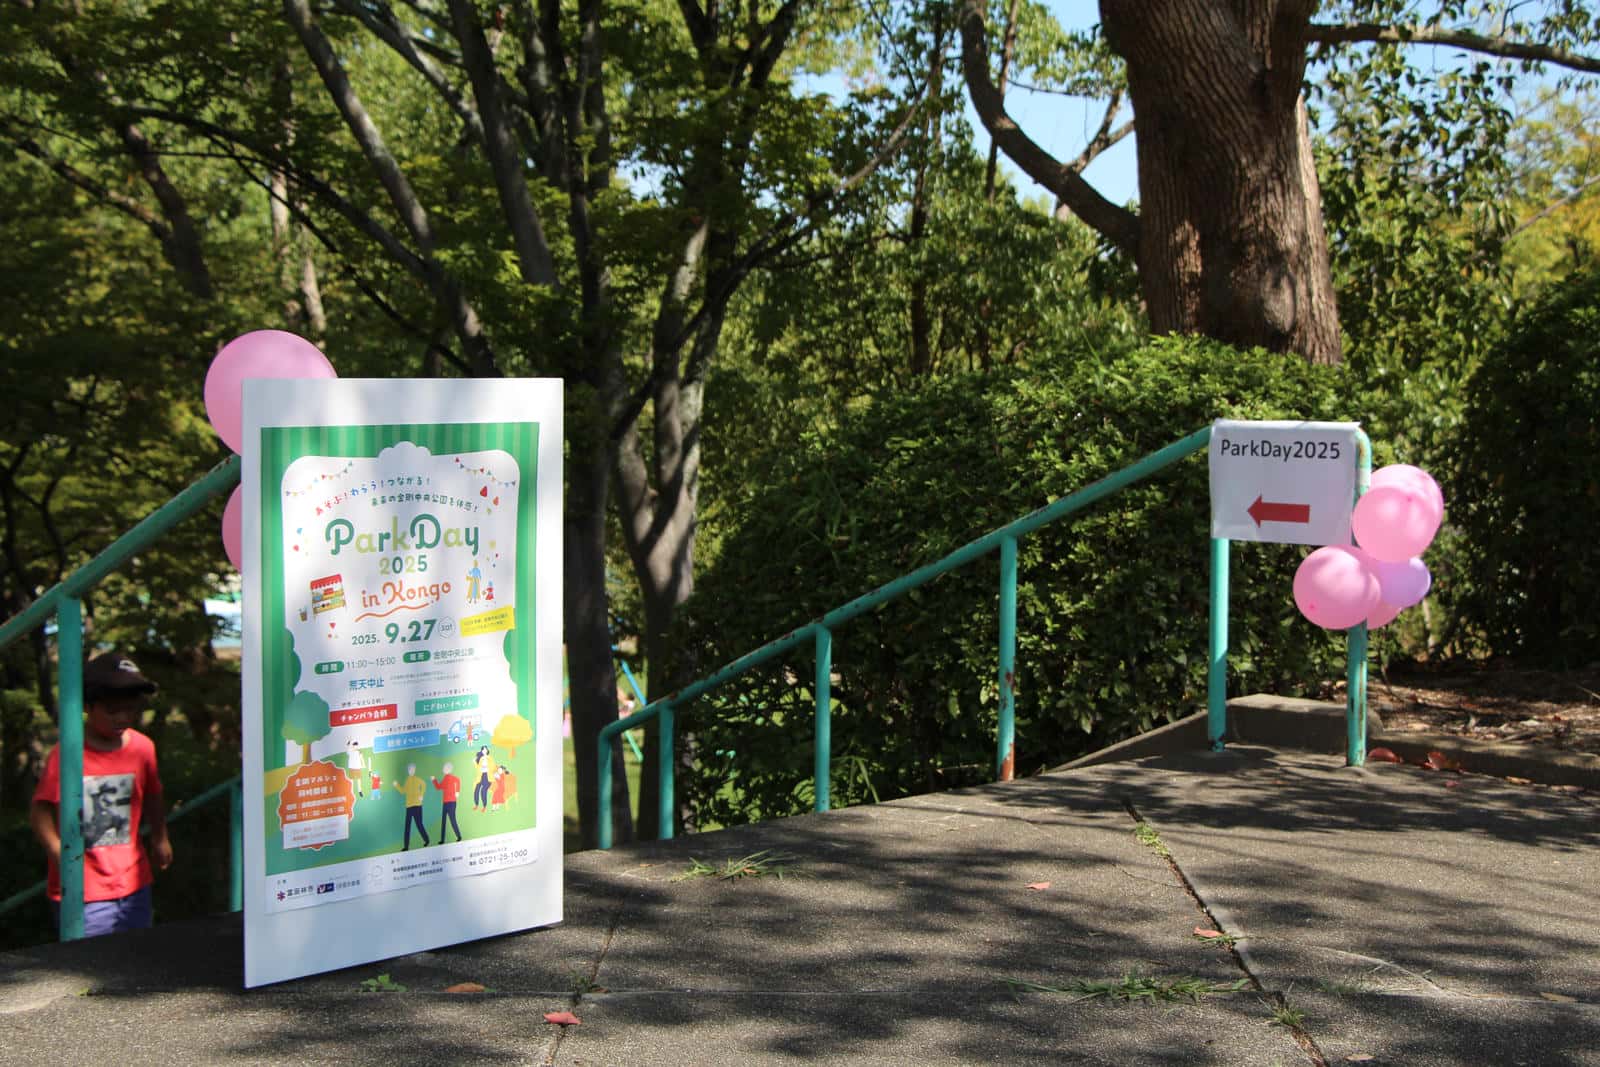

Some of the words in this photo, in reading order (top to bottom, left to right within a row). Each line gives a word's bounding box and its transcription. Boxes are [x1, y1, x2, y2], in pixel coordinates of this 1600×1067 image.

[1220, 439, 1340, 462] ParkDay2025
[379, 554, 428, 576] 2025
[361, 589, 380, 608] in
[382, 579, 452, 605] Kongo
[385, 618, 437, 644] 9.27
